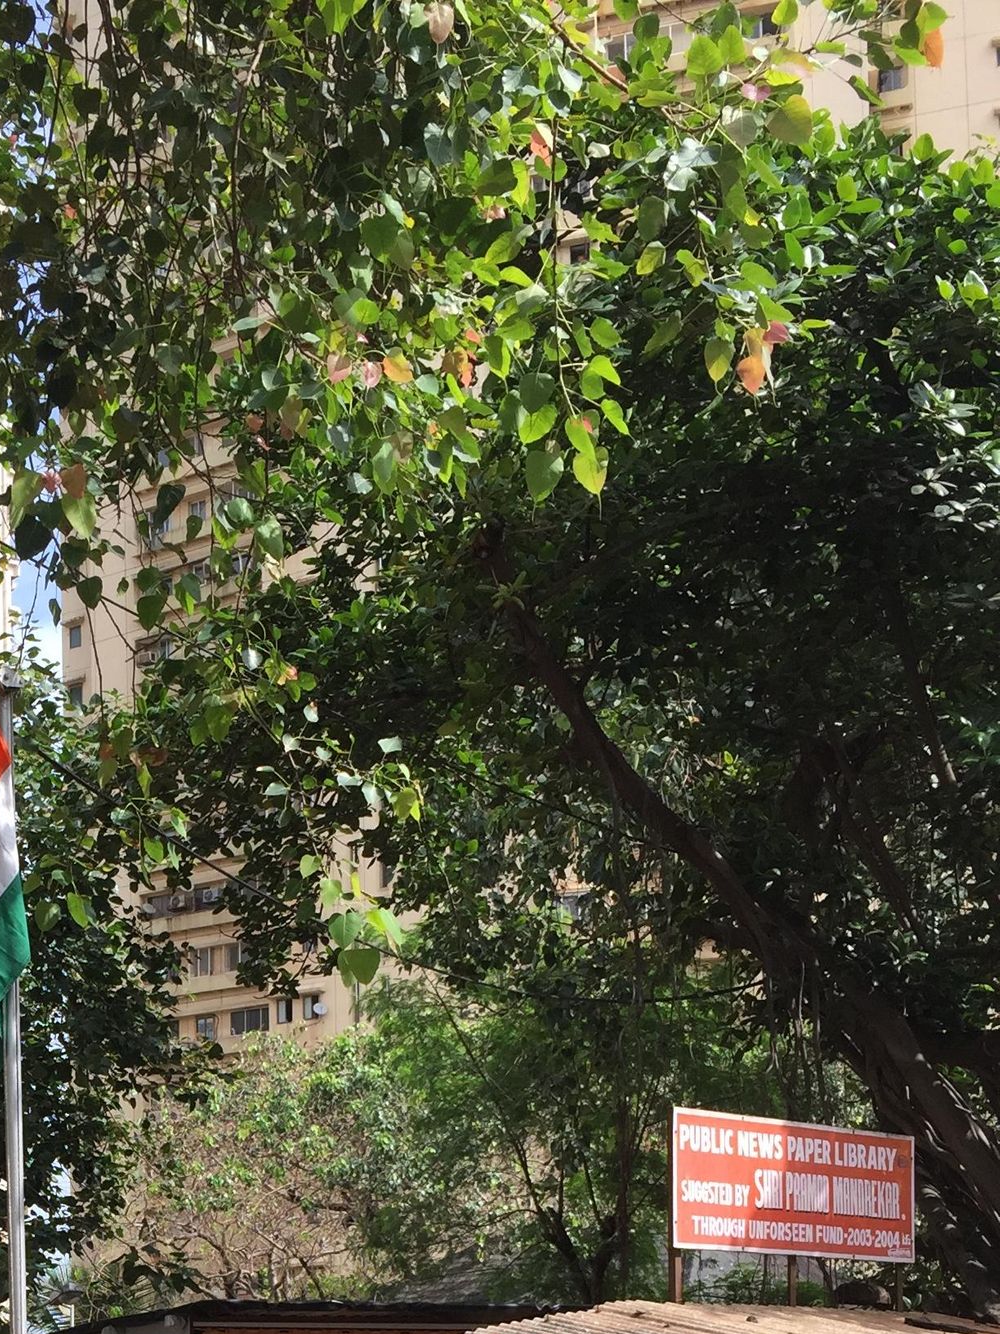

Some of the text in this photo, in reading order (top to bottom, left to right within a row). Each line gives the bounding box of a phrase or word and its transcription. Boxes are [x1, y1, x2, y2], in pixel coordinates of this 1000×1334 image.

[679, 1123, 897, 1172] PUBLIC NEWS PAPER LIBRARY
[681, 1179, 733, 1206] SUGGSTED
[735, 1183, 750, 1207] BY
[754, 1168, 783, 1211] SHRI
[785, 1171, 830, 1215] PRAMOD
[691, 1215, 746, 1239] THROUGH
[748, 1219, 814, 1244] UNFORSEEN
